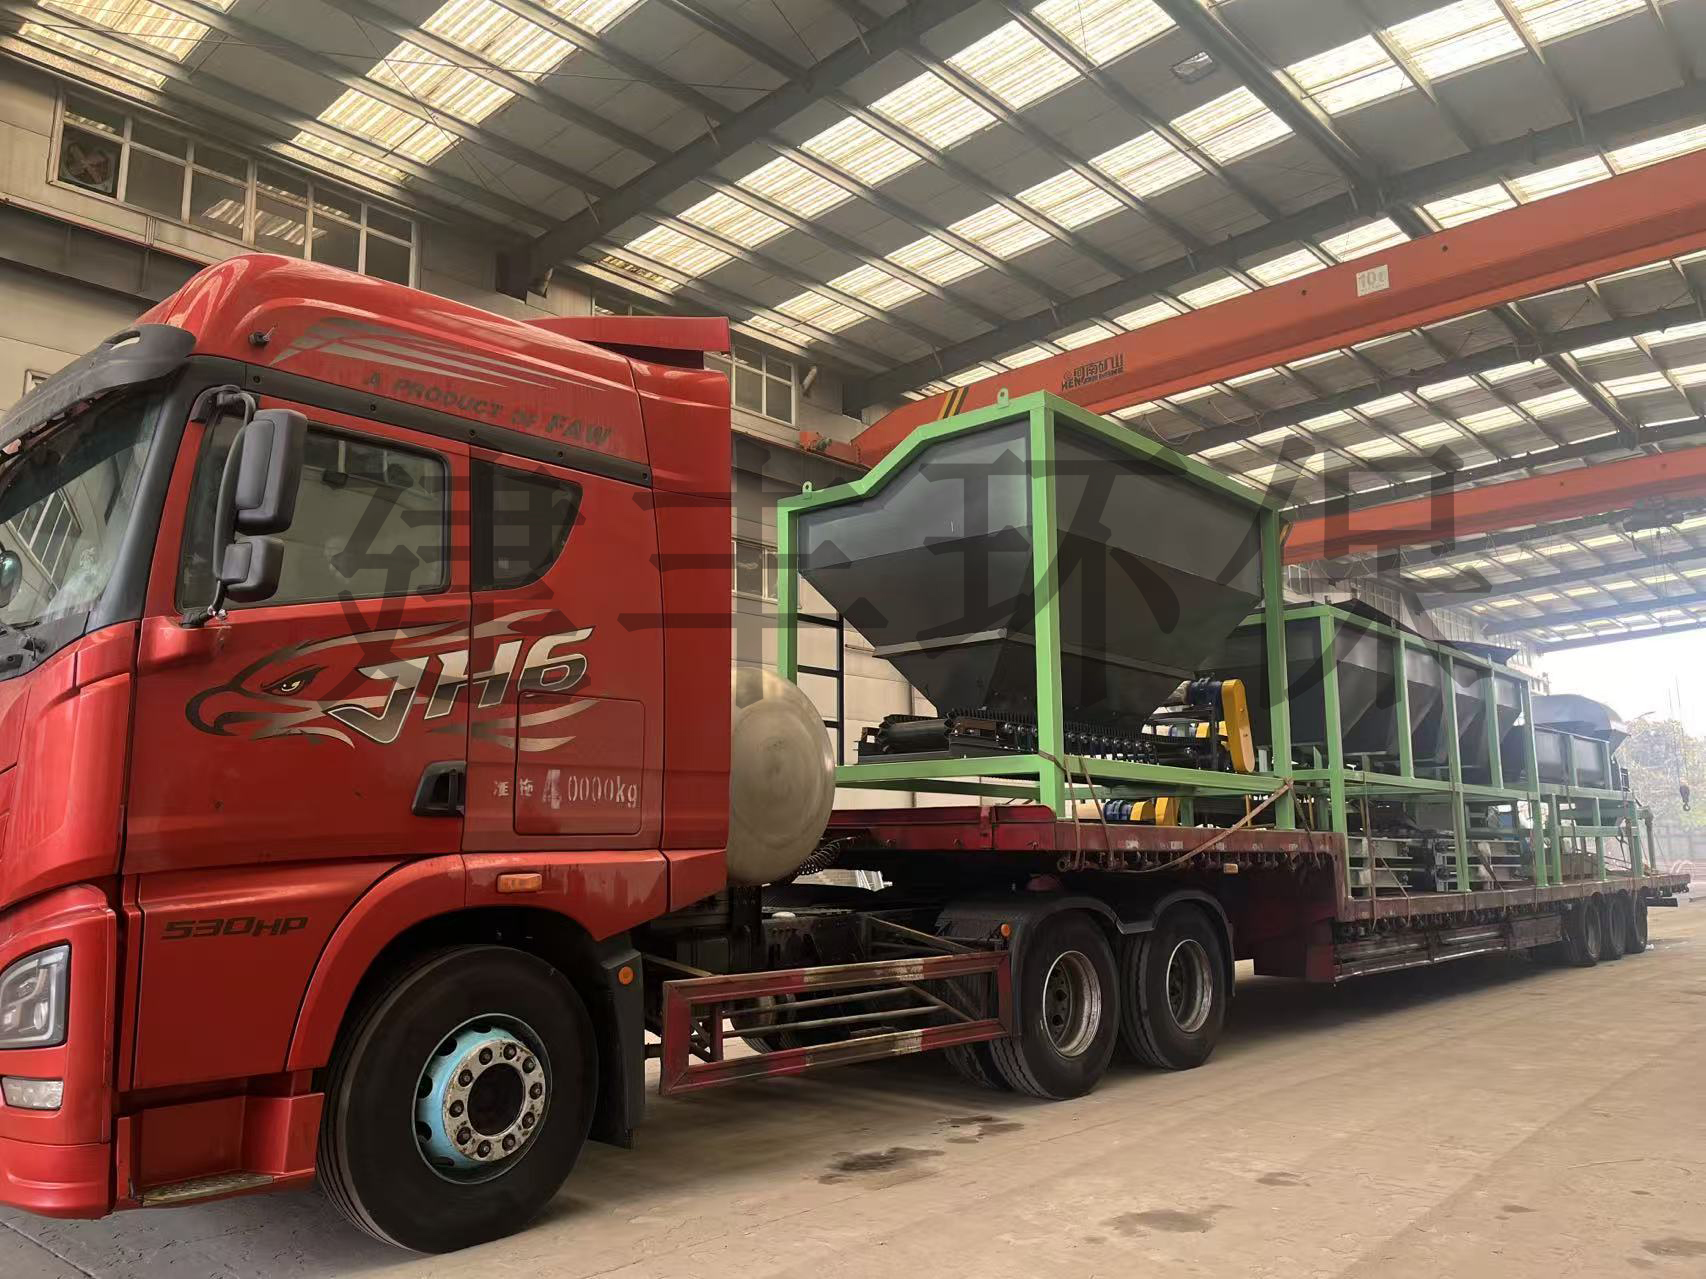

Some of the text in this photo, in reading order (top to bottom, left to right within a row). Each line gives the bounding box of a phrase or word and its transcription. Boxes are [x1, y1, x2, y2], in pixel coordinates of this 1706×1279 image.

[363, 372, 381, 387] A
[393, 377, 503, 416] PRODUCT
[545, 414, 613, 445] FAW
[326, 624, 597, 744] JH6
[160, 916, 308, 941] 530HP
